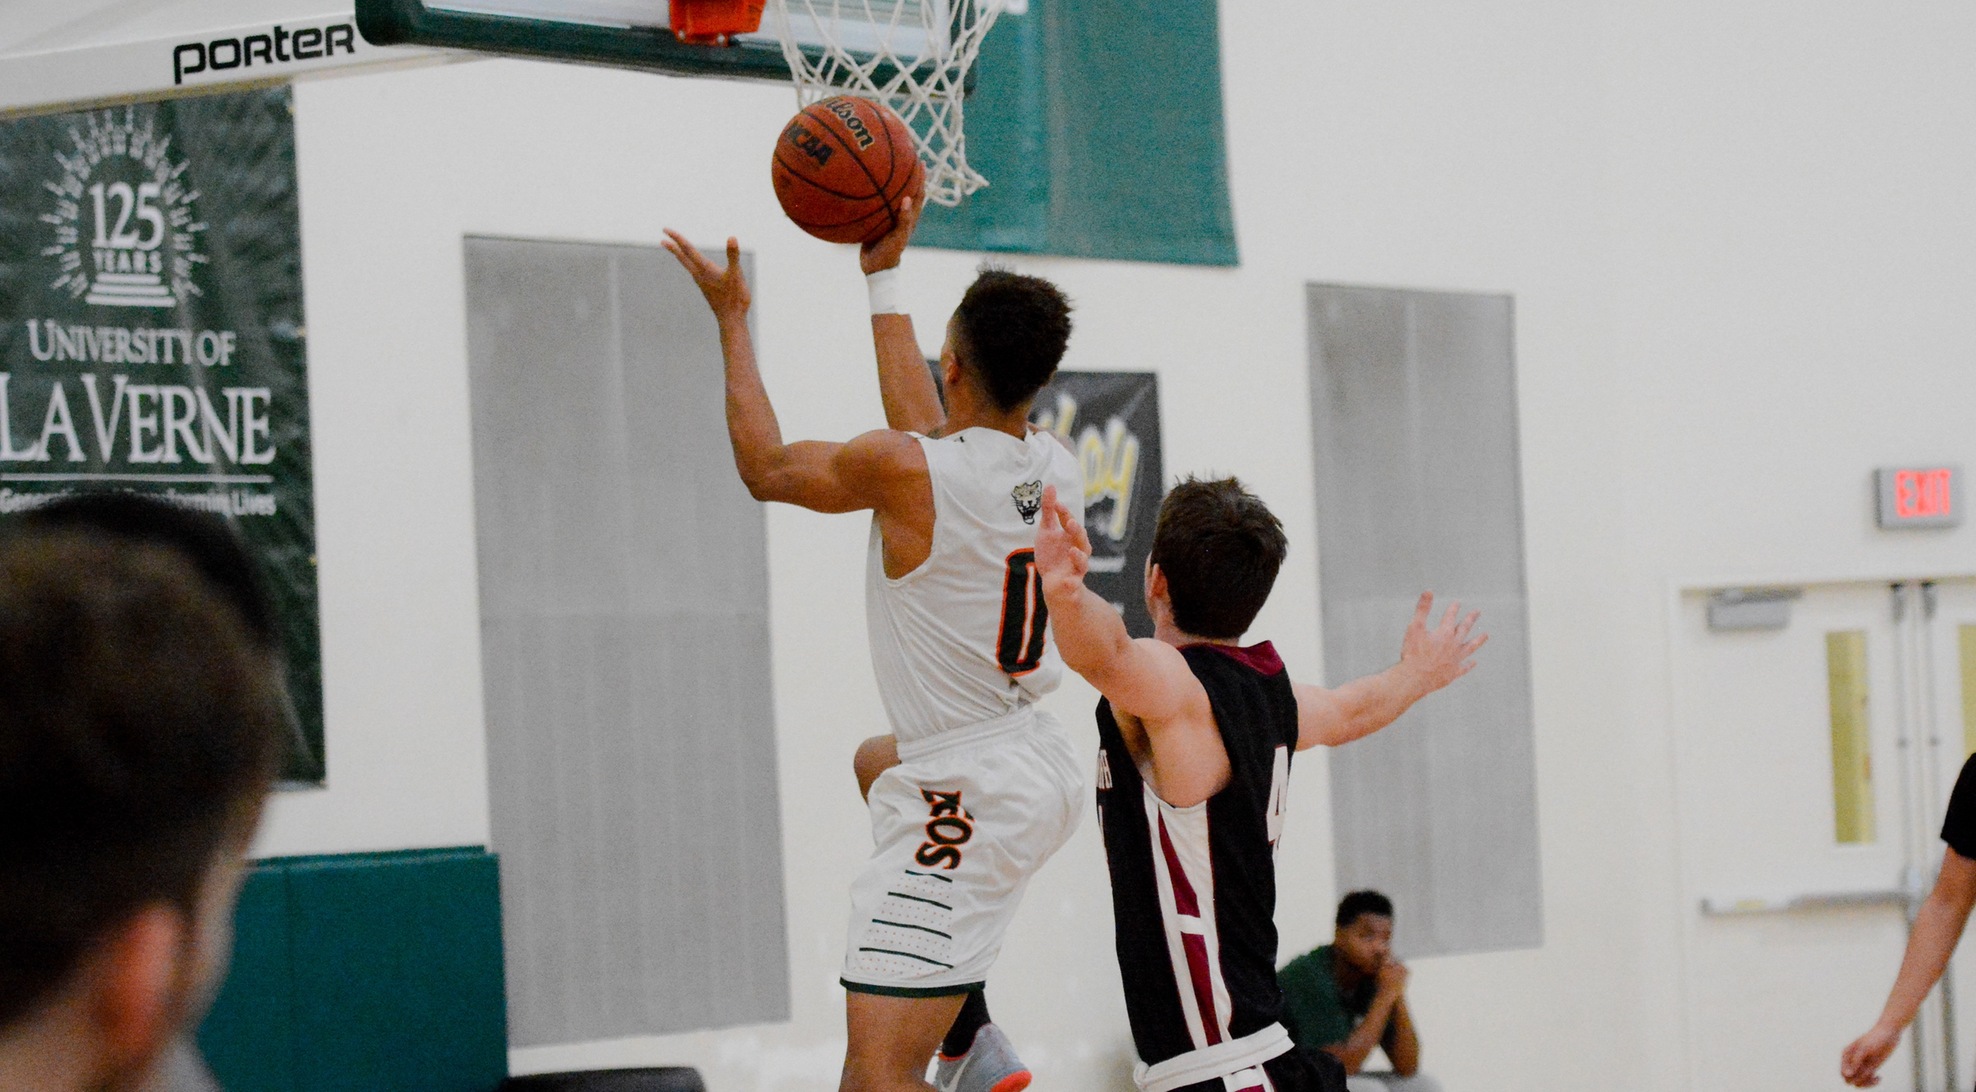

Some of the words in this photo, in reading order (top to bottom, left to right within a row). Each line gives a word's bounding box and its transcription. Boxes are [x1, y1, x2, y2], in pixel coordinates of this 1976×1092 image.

[89, 182, 165, 250] 125
[26, 318, 194, 366] UNIVERSITY
[194, 329, 237, 366] OF
[81, 373, 277, 465] VERNE
[1895, 468, 1952, 518] EXIT
